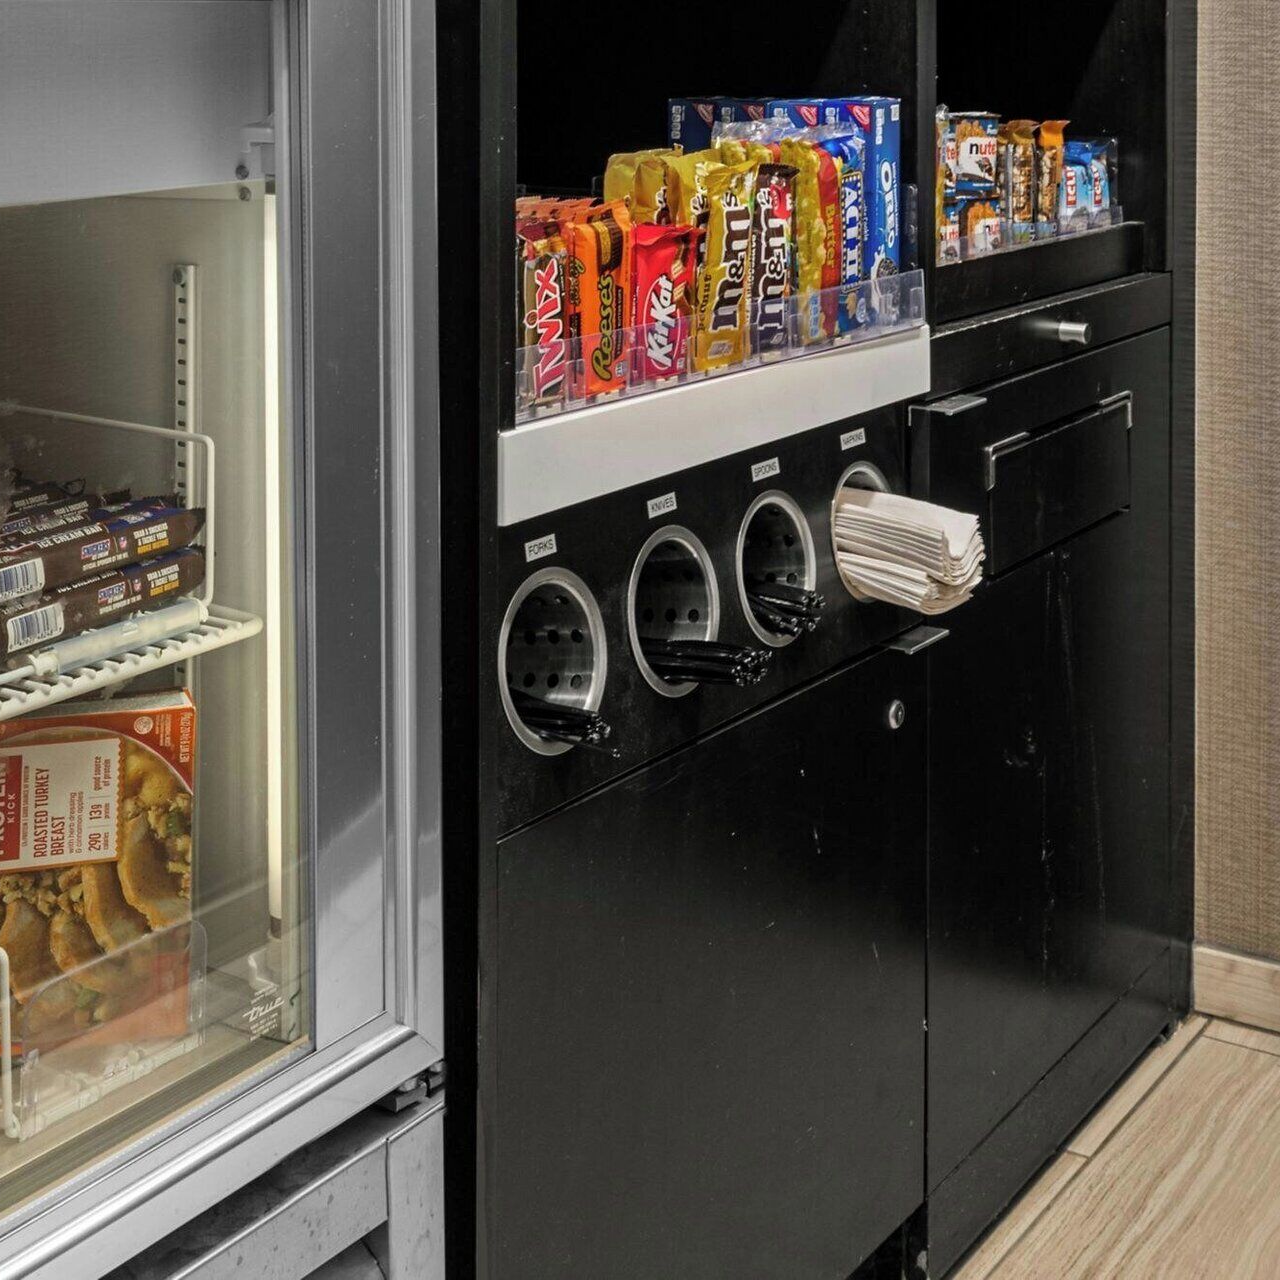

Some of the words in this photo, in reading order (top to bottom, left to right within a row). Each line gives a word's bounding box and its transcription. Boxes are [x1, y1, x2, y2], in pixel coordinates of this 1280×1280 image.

[843, 185, 860, 241] ACT
[880, 158, 896, 250] OREO
[825, 204, 836, 268] Butter
[592, 272, 614, 382] Reese's
[752, 462, 779, 478] SPOONS
[649, 496, 676, 514] KNIVES
[37, 539, 52, 549] ICE
[53, 528, 84, 544] CREAM
[84, 523, 103, 535] BAR
[528, 539, 556, 558] FORKS
[7, 792, 16, 824] KICK
[35, 768, 49, 808] TURKEY
[34, 810, 48, 858] ROASTED
[51, 816, 65, 856] BREAST
[89, 832, 102, 851] 290
